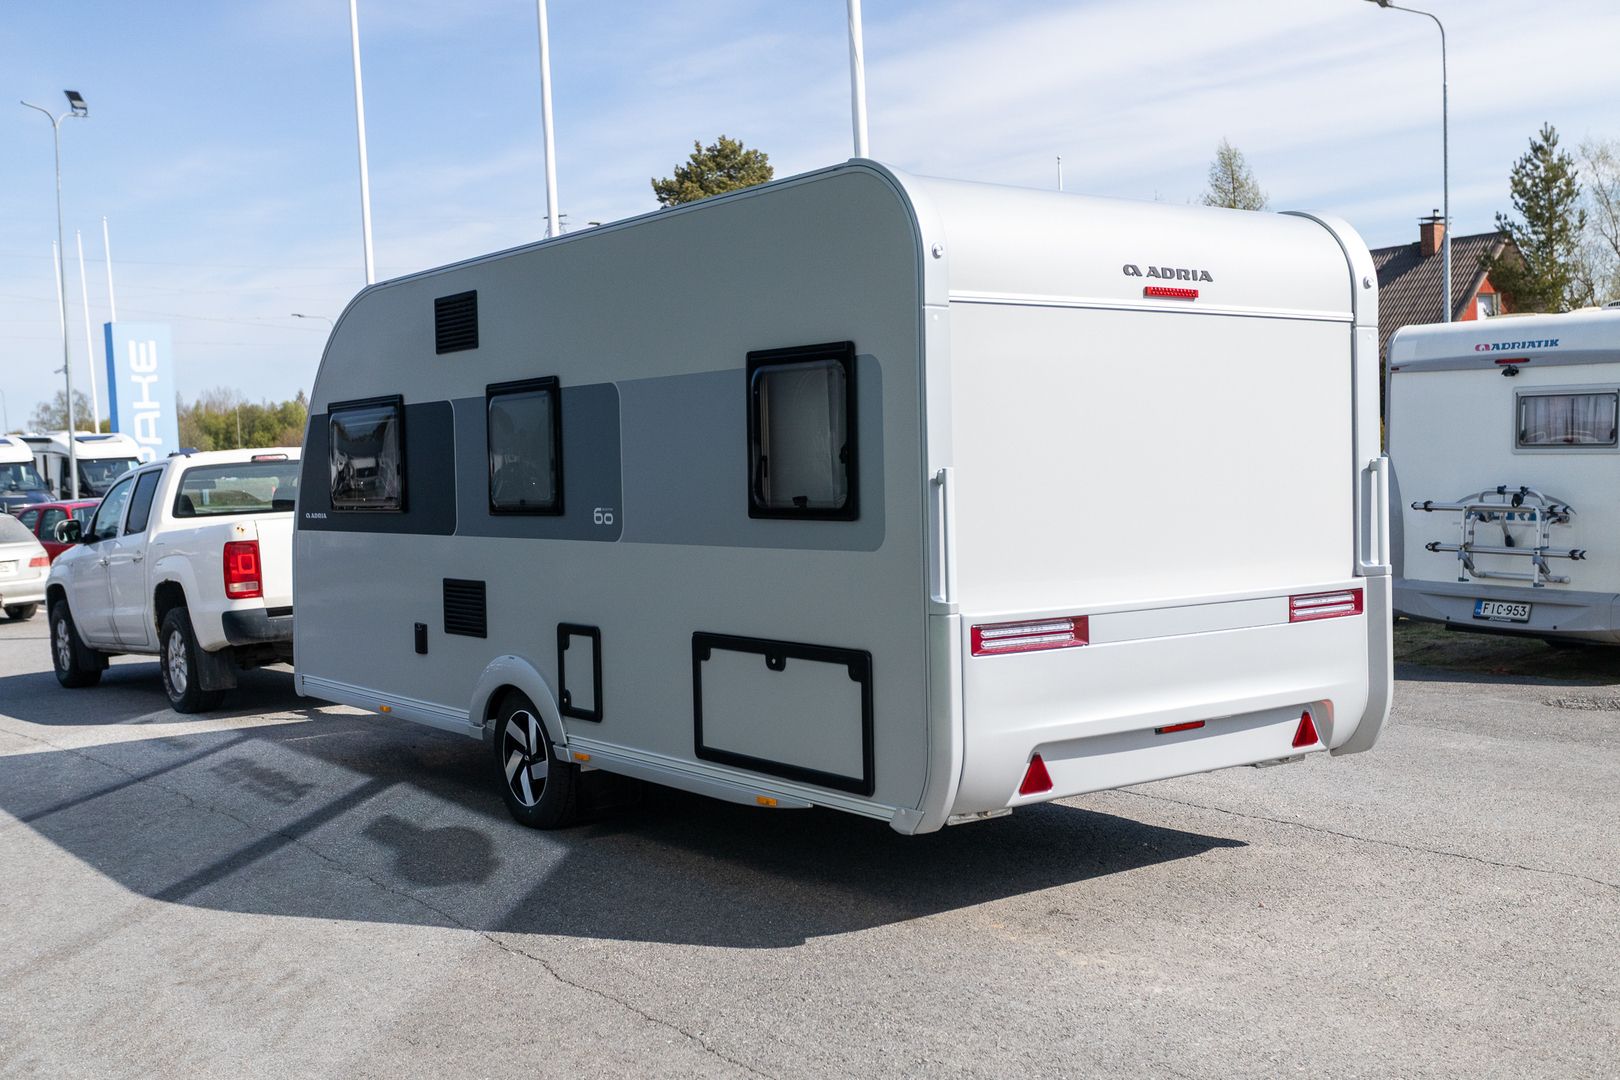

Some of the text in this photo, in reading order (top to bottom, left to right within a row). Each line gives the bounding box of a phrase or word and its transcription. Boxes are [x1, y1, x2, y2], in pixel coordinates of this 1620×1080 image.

[1146, 266, 1213, 282] ADRIA
[1491, 339, 1559, 351] ADRIATIK
[594, 507, 613, 525] 60
[1483, 603, 1527, 617] FIC-953
